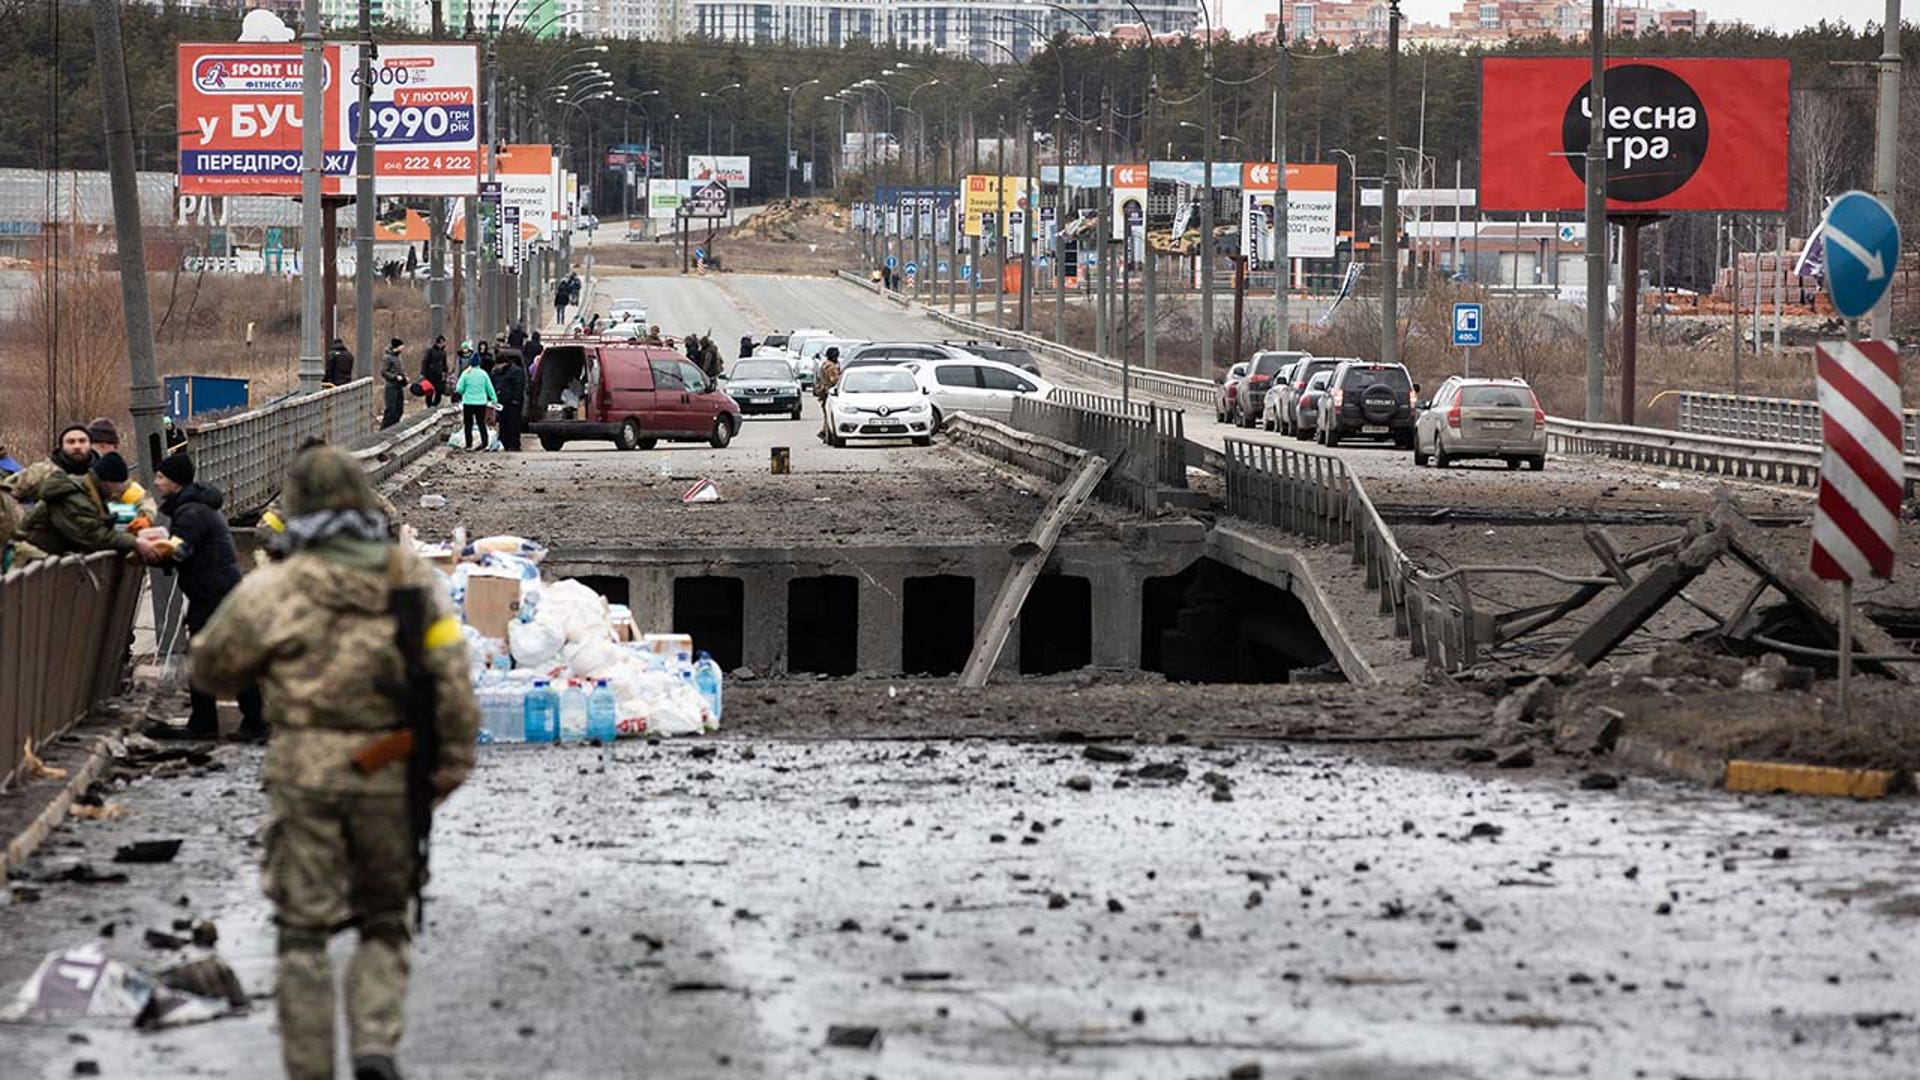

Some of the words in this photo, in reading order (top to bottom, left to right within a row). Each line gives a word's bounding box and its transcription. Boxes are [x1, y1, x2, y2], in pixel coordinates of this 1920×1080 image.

[231, 63, 282, 76] SPORT
[401, 92, 410, 105] у
[413, 90, 469, 104] лютому
[450, 111, 469, 120] грн
[1581, 96, 1697, 130] Чесна
[197, 116, 219, 145] у
[231, 104, 304, 138] БУЧ
[450, 123, 469, 134] рік
[197, 154, 349, 172] ПЕРЕДПРОЖ!
[404, 156, 430, 169] 222
[433, 156, 442, 169] 4
[446, 156, 471, 169] 222
